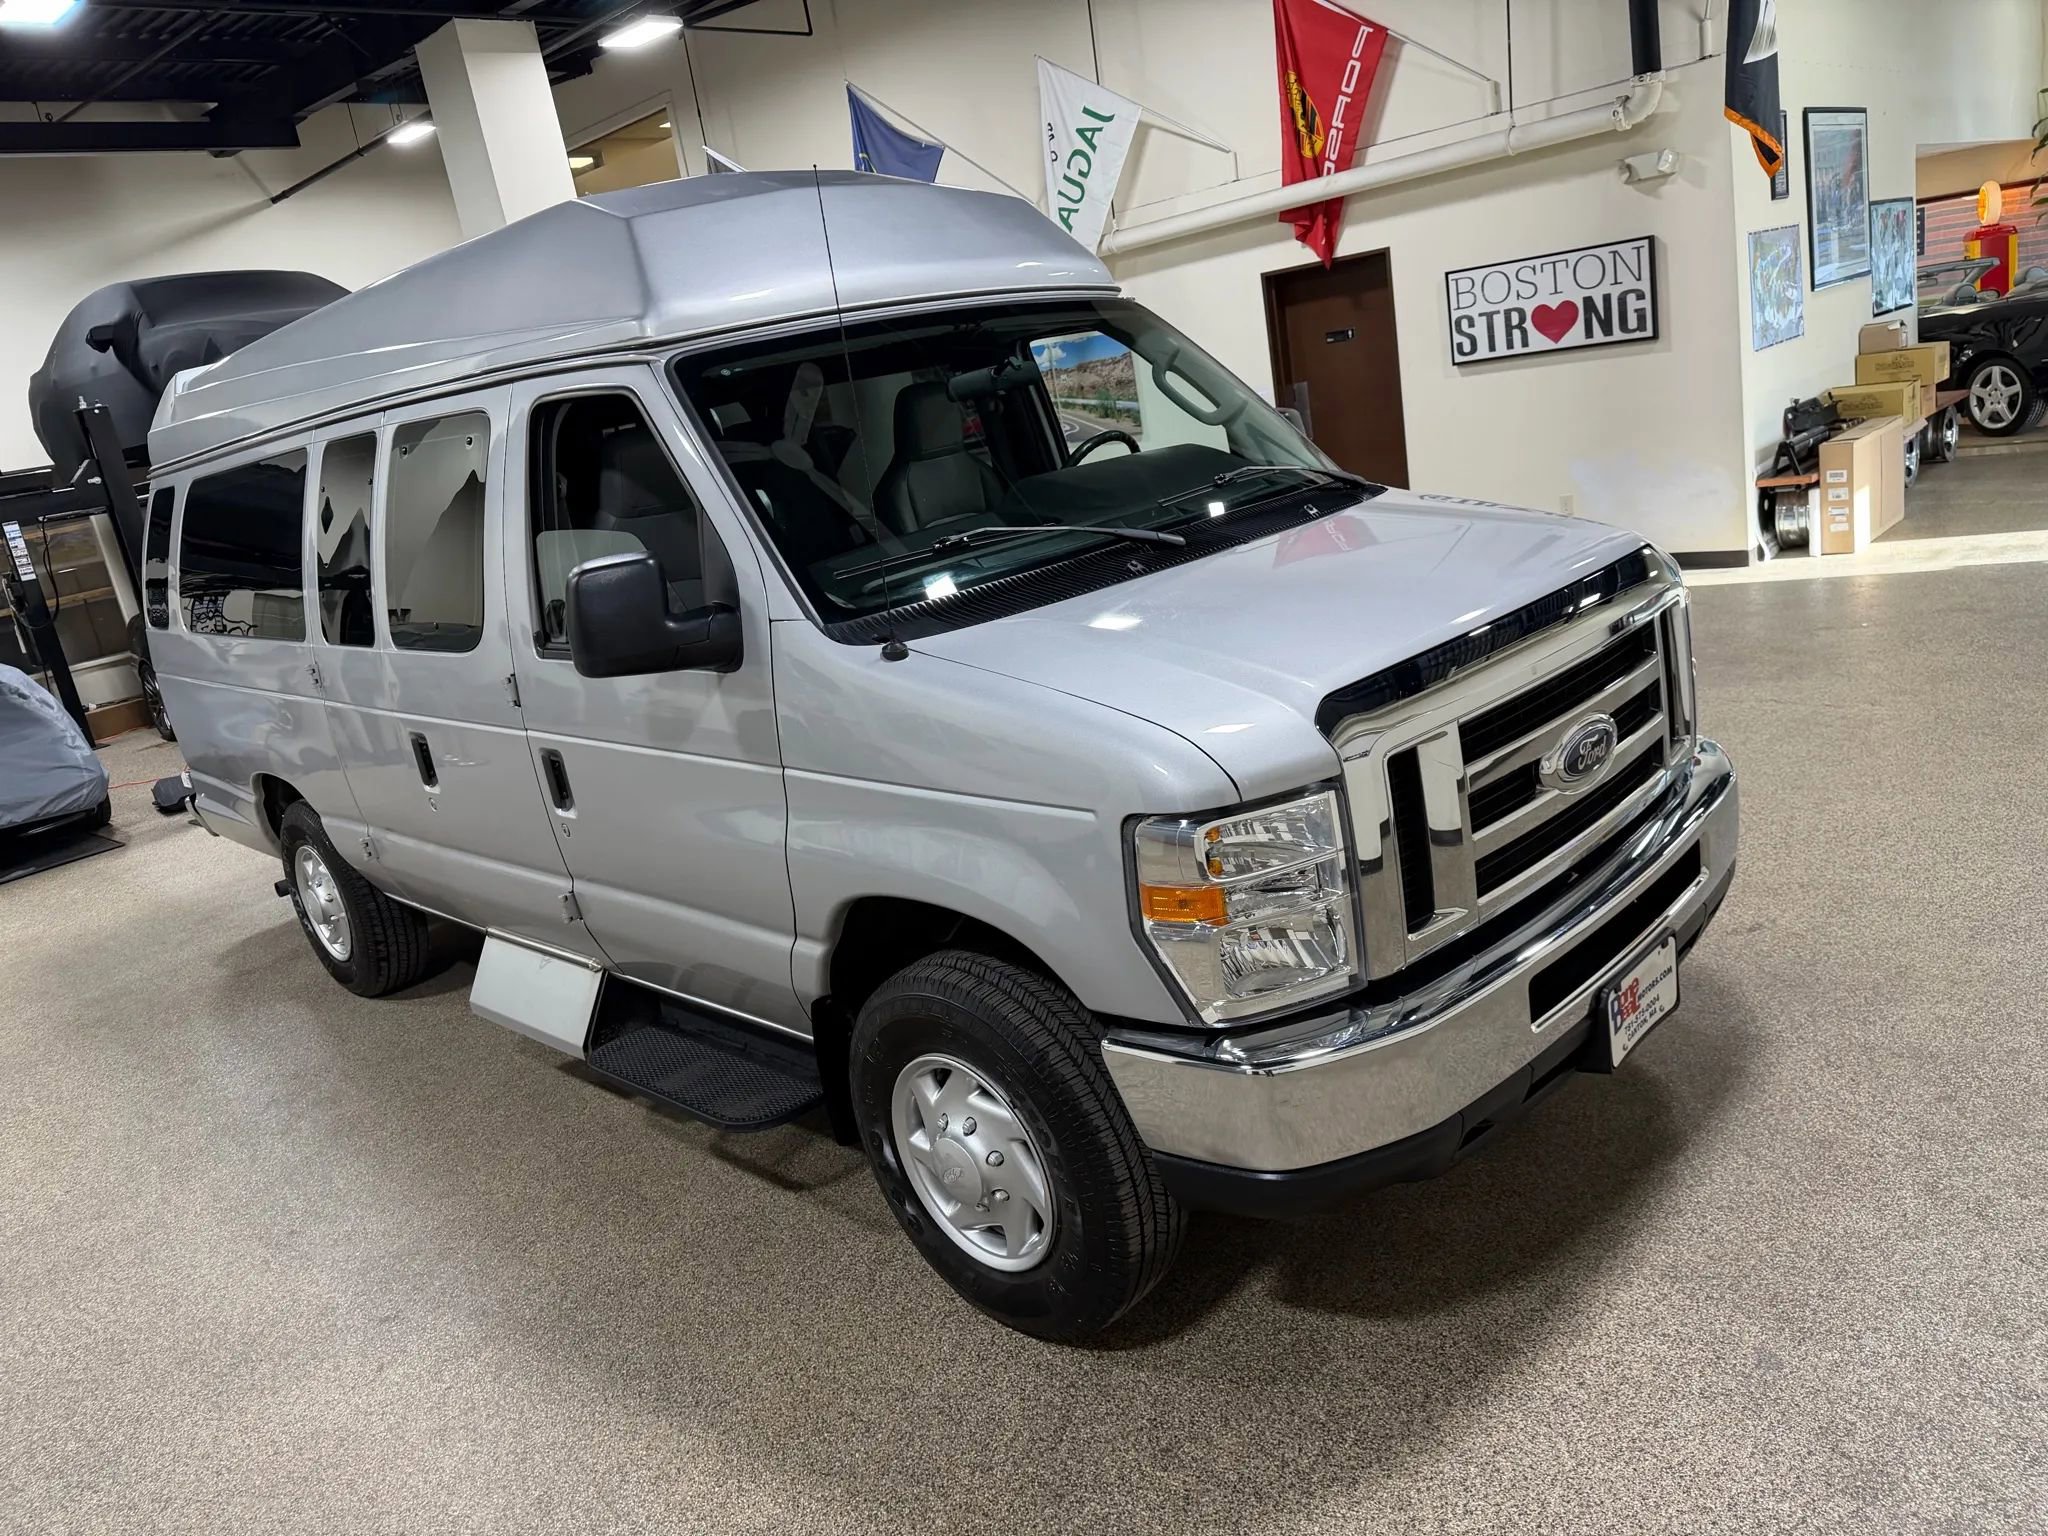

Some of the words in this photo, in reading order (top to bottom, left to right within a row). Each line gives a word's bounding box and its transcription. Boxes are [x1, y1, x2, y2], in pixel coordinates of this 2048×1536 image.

[1450, 245, 1646, 311] BOSTON
[1454, 288, 1648, 357] STRNG
[1577, 733, 1608, 770] Ford
